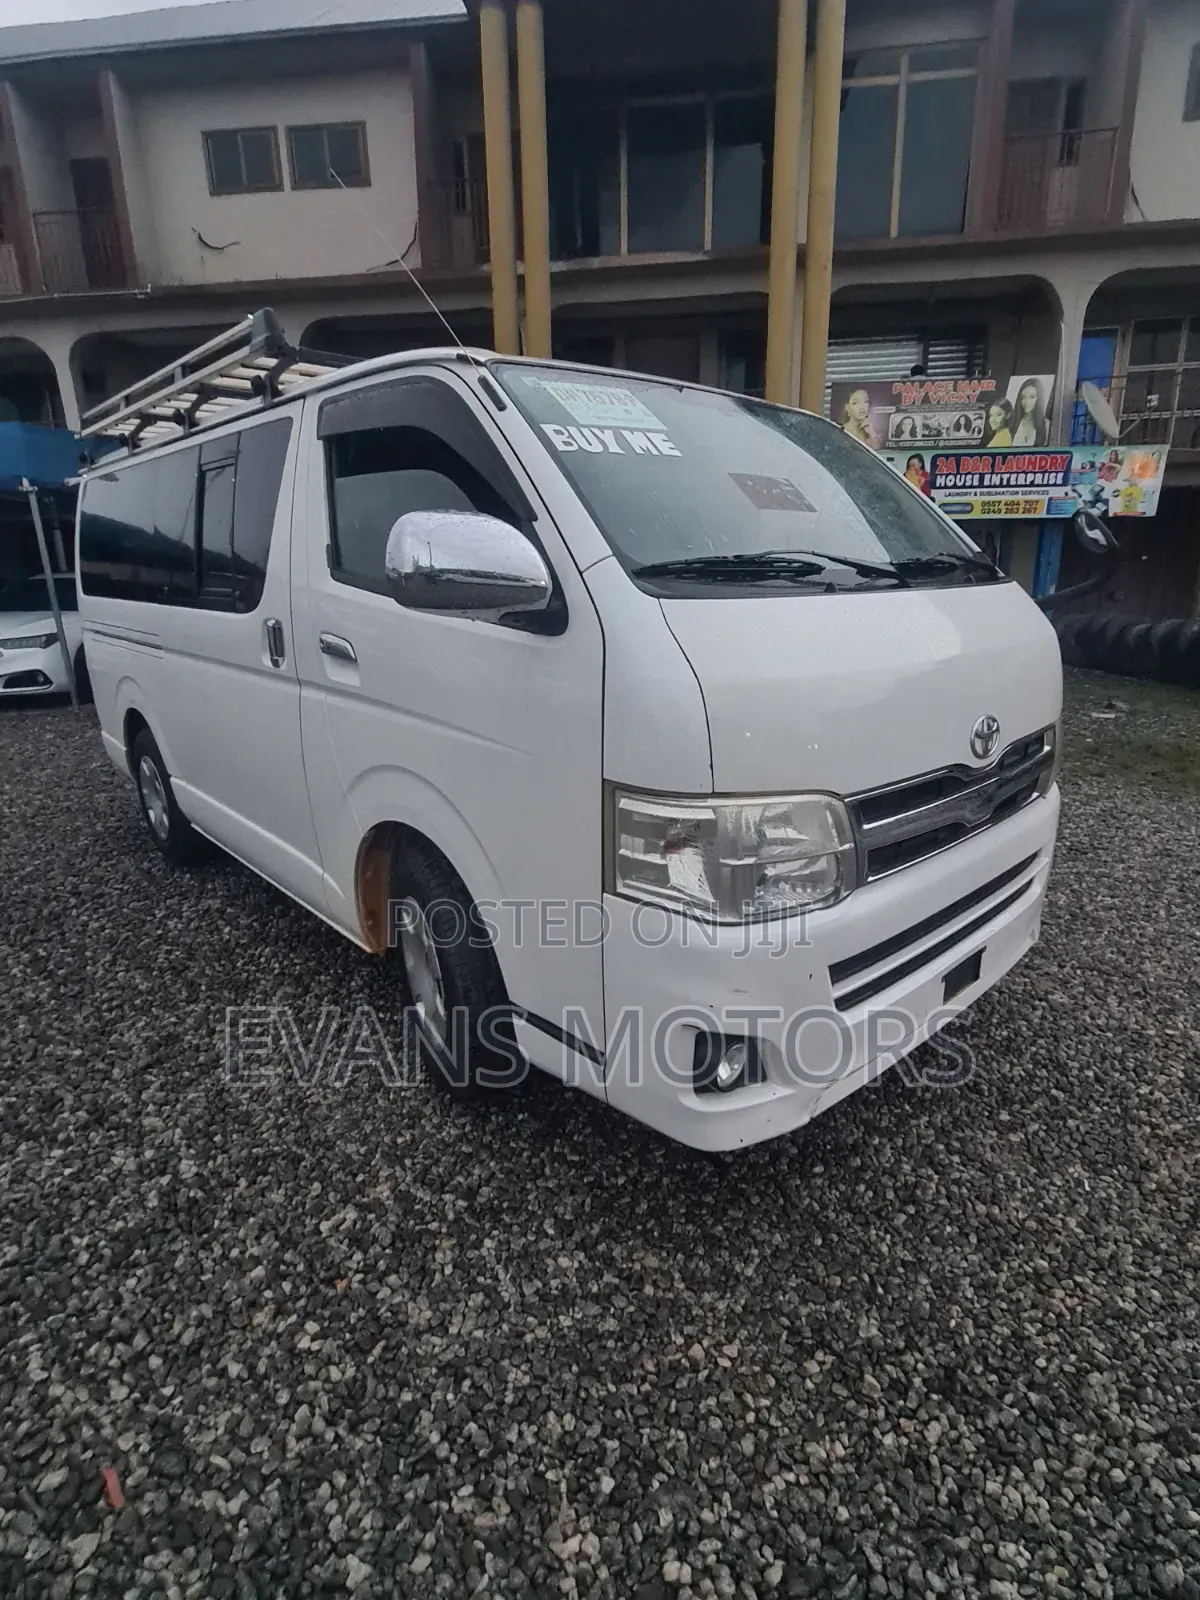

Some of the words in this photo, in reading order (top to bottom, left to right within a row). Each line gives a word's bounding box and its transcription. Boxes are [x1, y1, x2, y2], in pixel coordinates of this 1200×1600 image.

[892, 381, 954, 394] PALACE
[957, 380, 996, 391] HAIR
[902, 392, 924, 405] BY
[928, 389, 981, 404] VICKY
[540, 423, 626, 454] BUY
[620, 429, 682, 457] ME
[935, 456, 957, 474] 2A
[960, 456, 992, 473] B&R
[994, 454, 1071, 473] LAUNDRY
[935, 474, 980, 487] HOUSE
[983, 472, 1064, 486] ENTERPRISE
[944, 490, 972, 498] LAUNDRY
